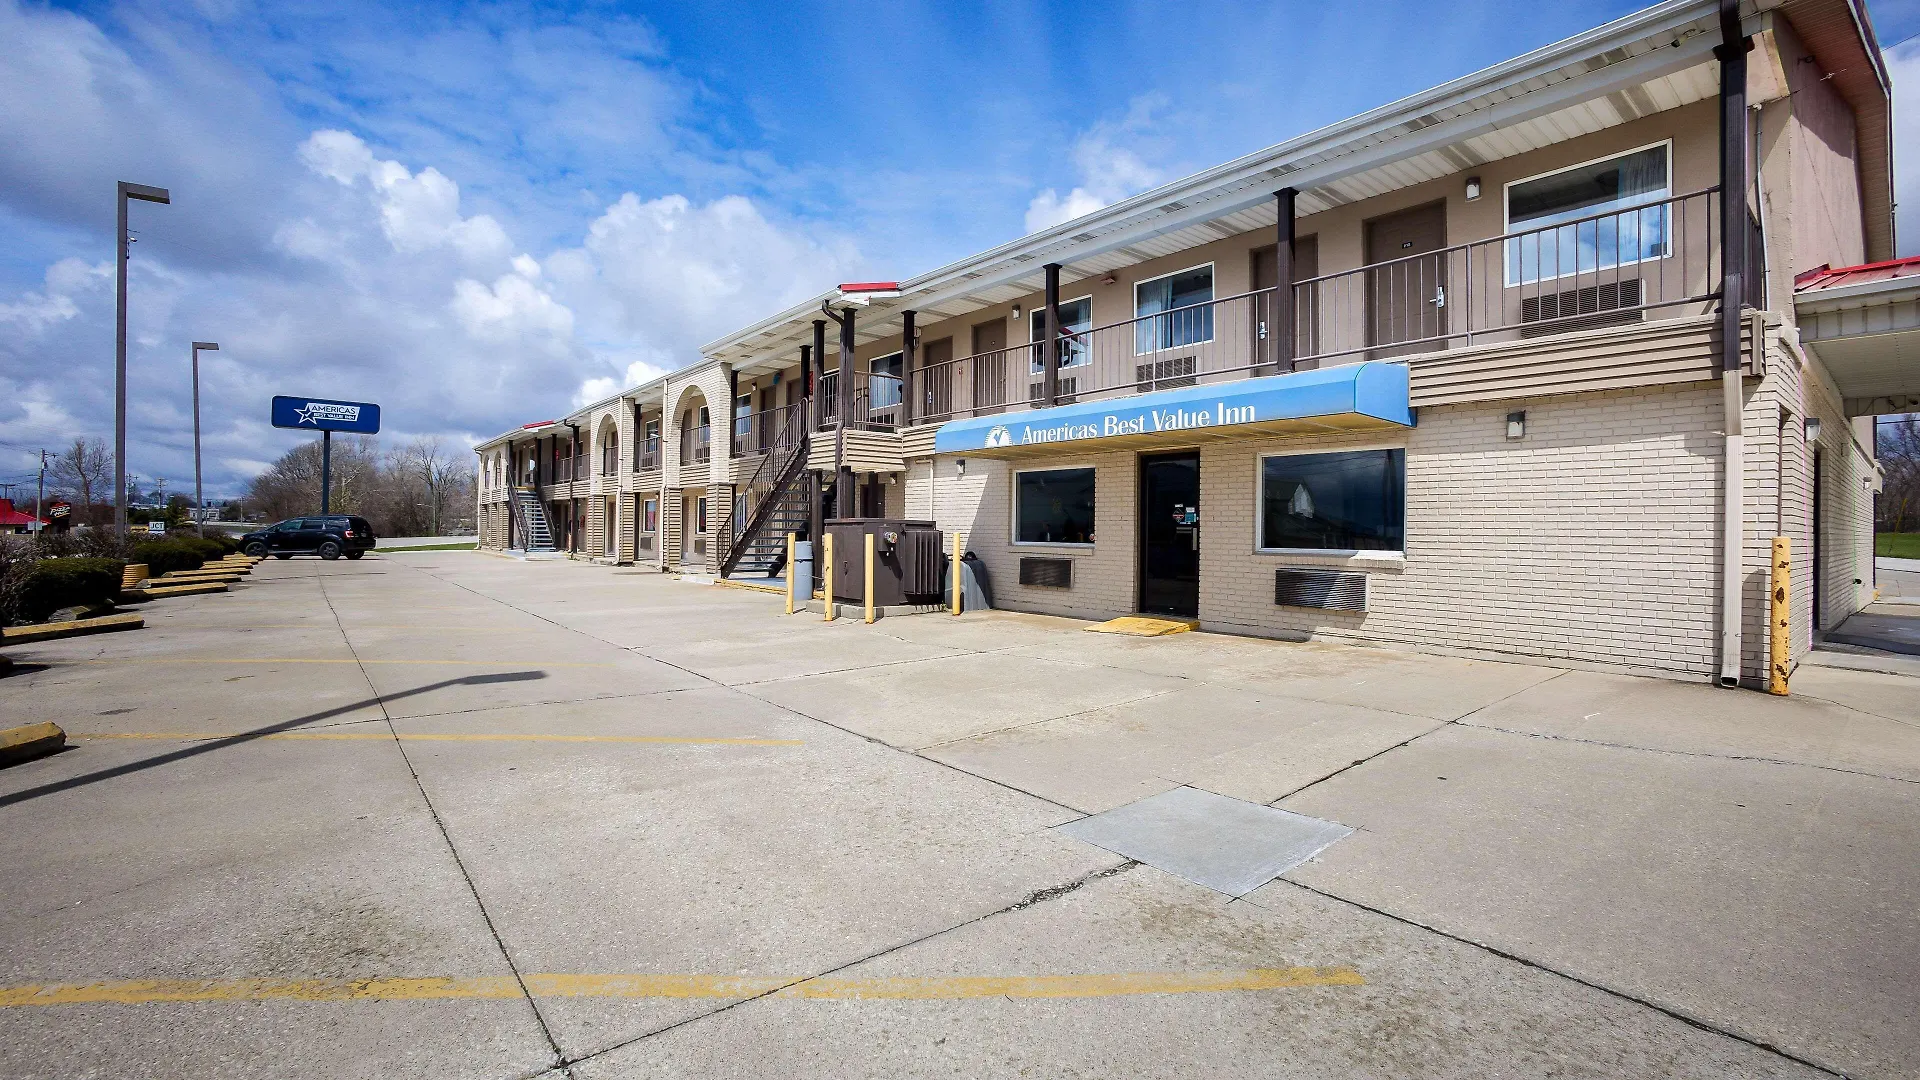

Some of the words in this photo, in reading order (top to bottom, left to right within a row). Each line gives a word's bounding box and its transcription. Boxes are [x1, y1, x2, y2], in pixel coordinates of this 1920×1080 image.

[312, 405, 355, 414] AMERICAS
[1021, 422, 1097, 445] Americas
[1104, 415, 1145, 435] Best
[1151, 409, 1210, 431] Value
[1217, 402, 1256, 424] Inn
